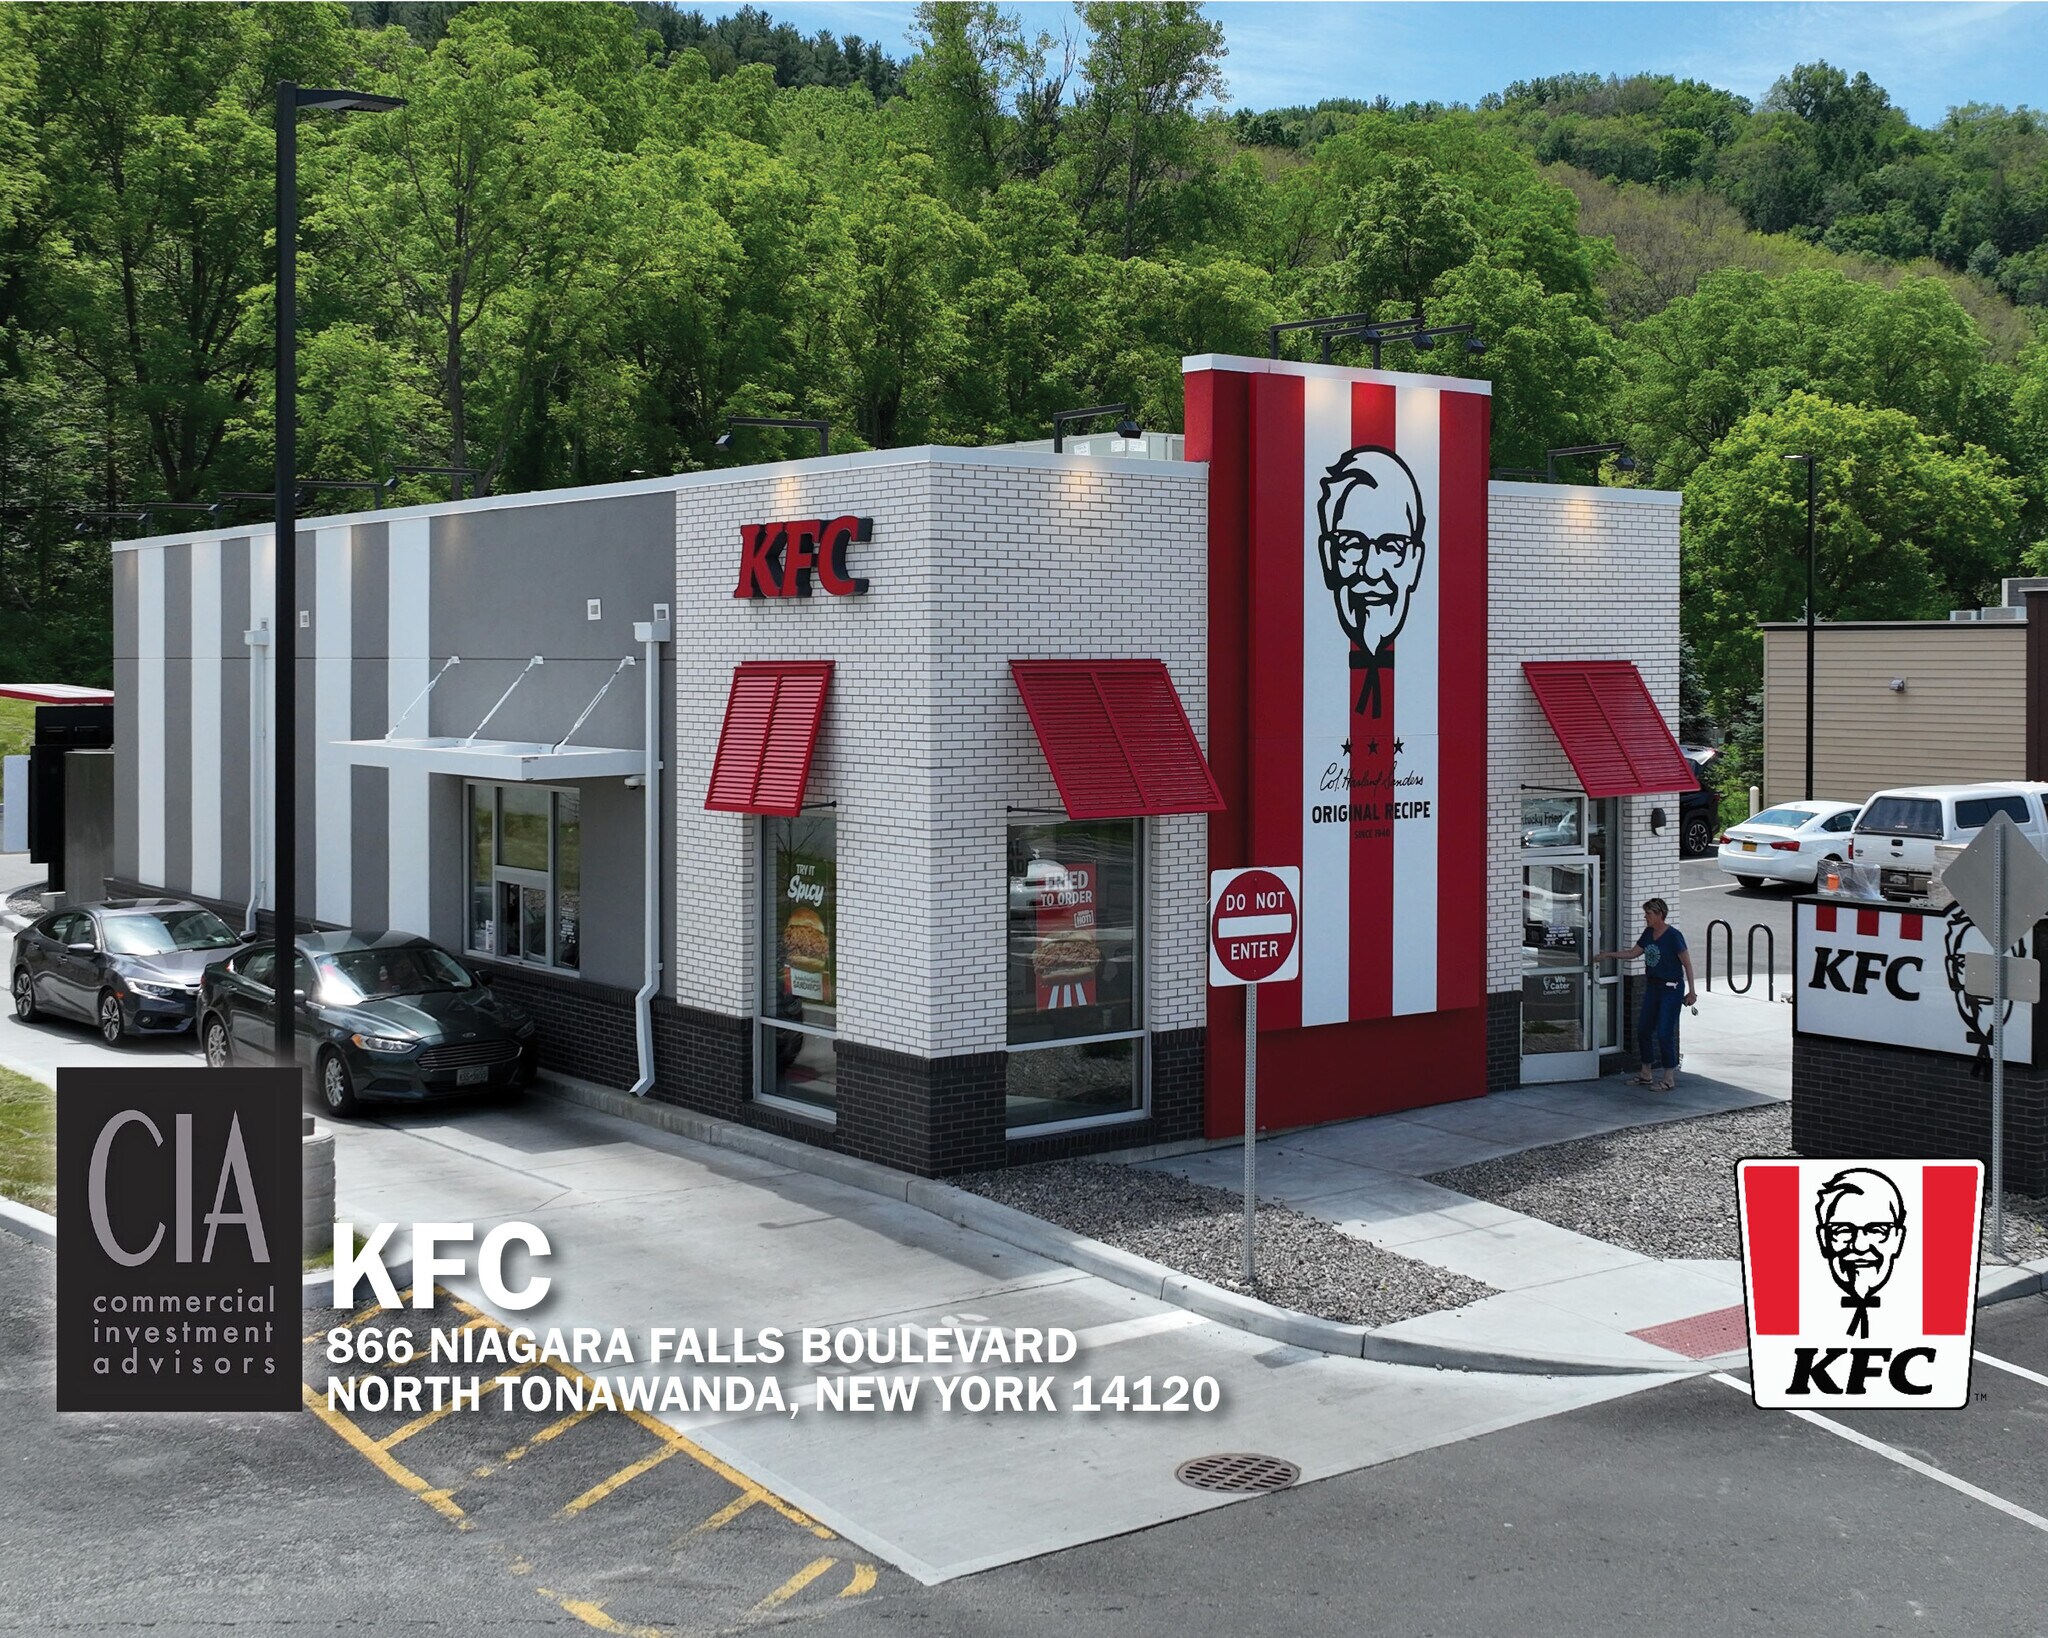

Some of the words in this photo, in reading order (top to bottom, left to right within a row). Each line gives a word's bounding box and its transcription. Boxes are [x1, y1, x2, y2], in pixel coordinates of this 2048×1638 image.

[733, 515, 872, 599] KFC
[1312, 804, 1379, 823] ORIGINAL
[1385, 801, 1431, 820] RECIPE
[1354, 829, 1372, 839] SINCE
[796, 864, 808, 875] TRY
[809, 866, 815, 876] IT
[787, 875, 824, 907] Spicy
[1045, 871, 1088, 891] FRIED
[1041, 893, 1054, 907] TO
[1057, 890, 1092, 906] ORDER
[1226, 894, 1246, 911] DO
[1256, 891, 1285, 909] NOT
[1231, 941, 1278, 960] ENTER
[1808, 946, 1924, 1002] KFC
